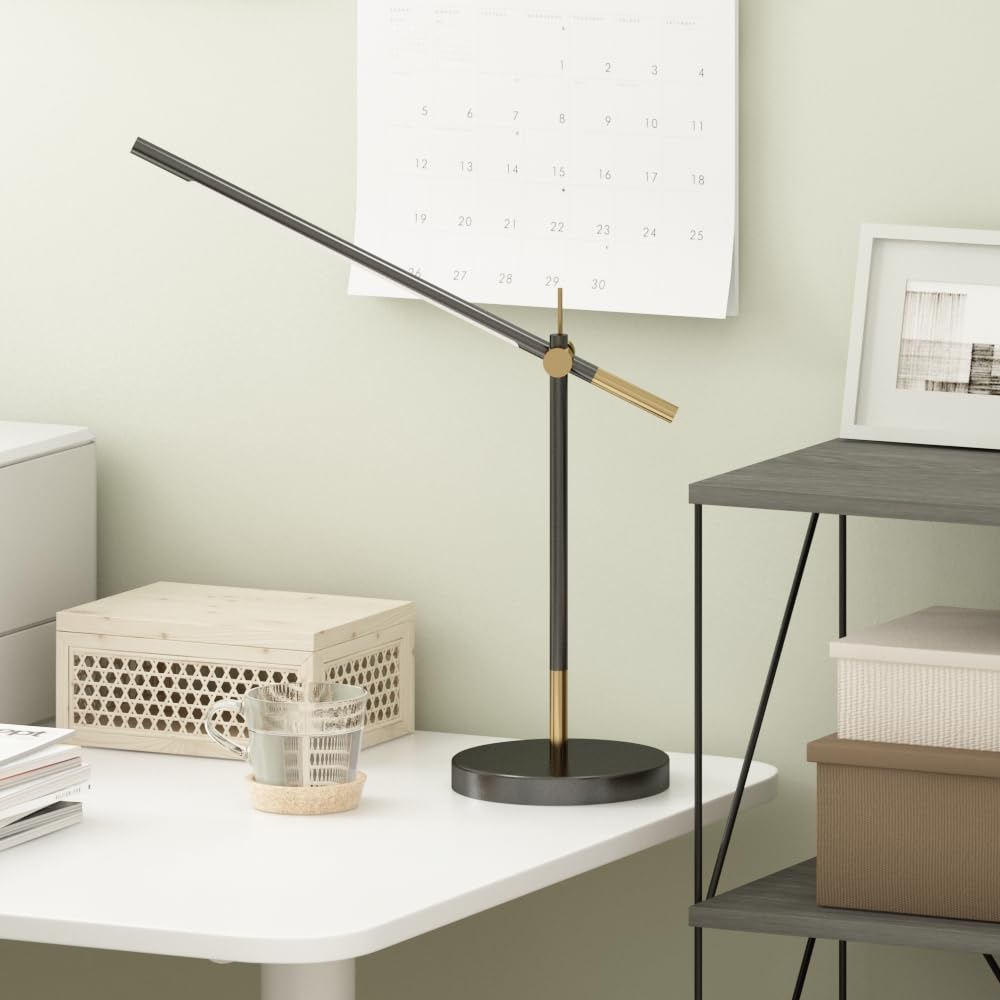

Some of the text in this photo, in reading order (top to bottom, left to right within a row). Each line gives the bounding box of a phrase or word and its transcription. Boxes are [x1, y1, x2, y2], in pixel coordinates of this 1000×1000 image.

[604, 62, 612, 73] 2
[651, 65, 658, 76] 3
[698, 67, 705, 78] 4
[421, 106, 704, 132] 5 6 7 8 9 10 11
[415, 158, 705, 186] 12 13 14 15 16 17 18
[414, 212, 704, 242] 19 20 21 22 23 24 25
[453, 270, 468, 282] 27
[498, 272, 513, 285] 28
[545, 276, 560, 288] 29
[592, 278, 606, 291] 30
